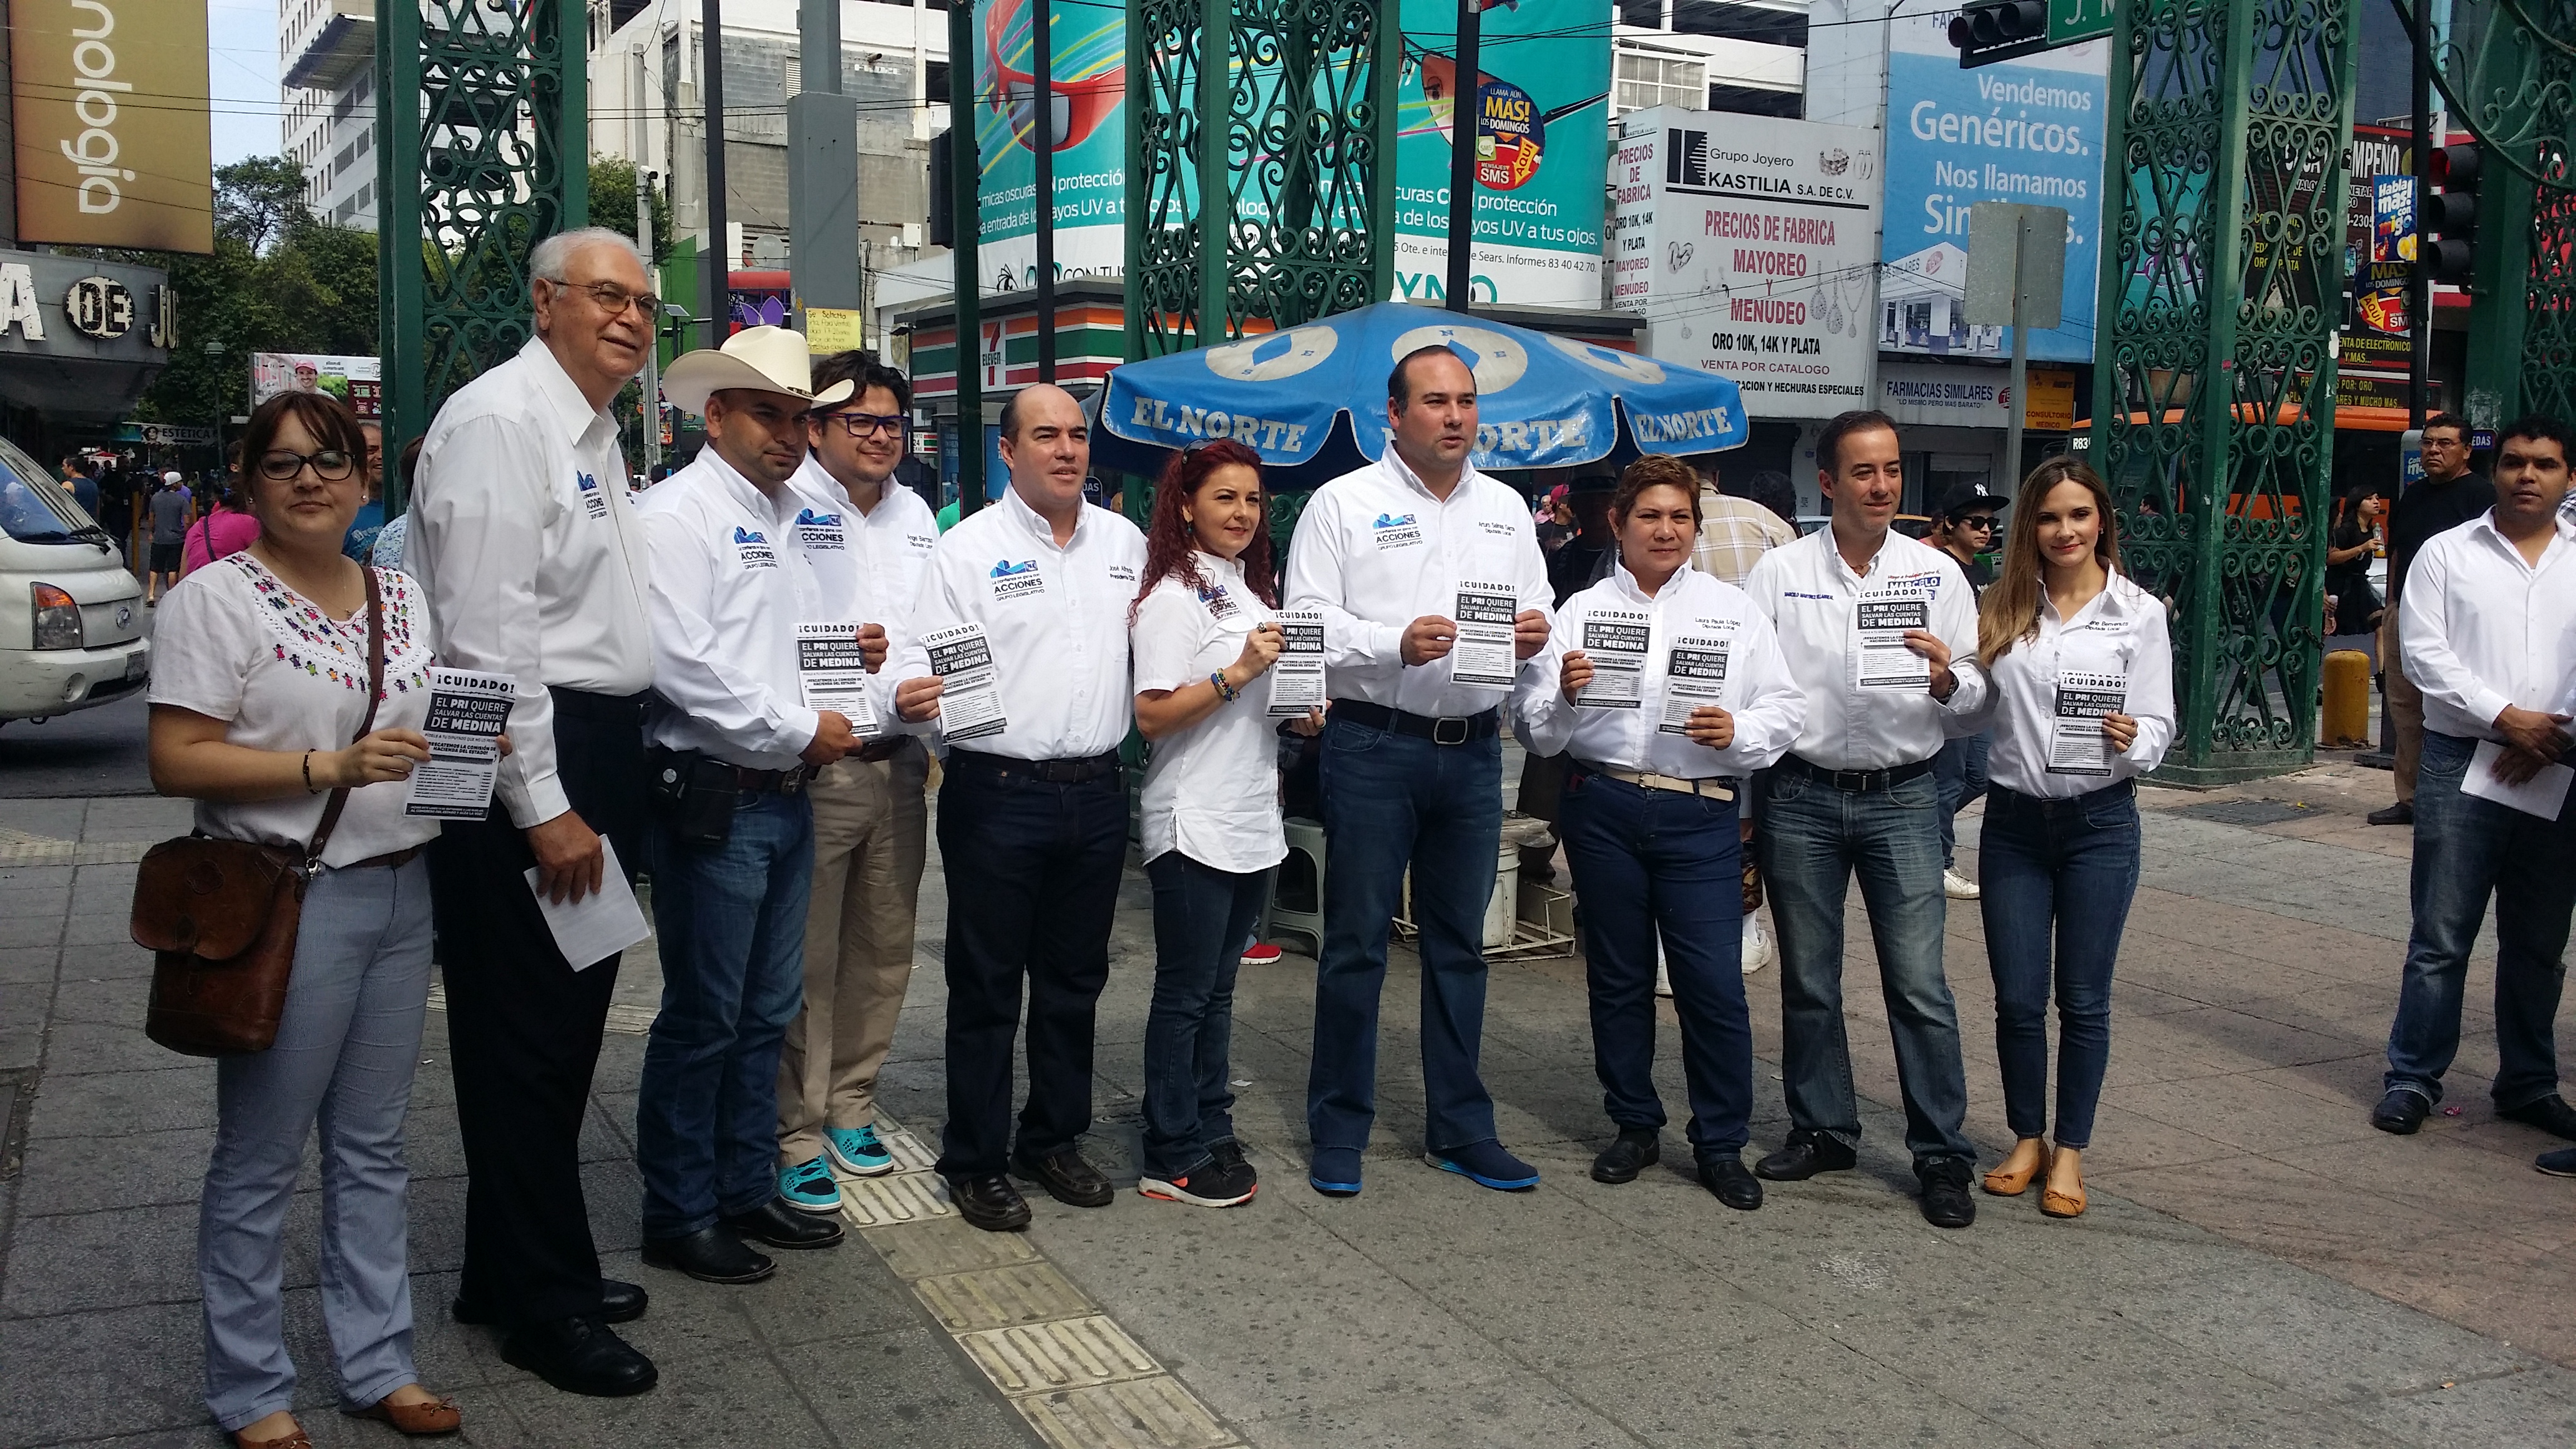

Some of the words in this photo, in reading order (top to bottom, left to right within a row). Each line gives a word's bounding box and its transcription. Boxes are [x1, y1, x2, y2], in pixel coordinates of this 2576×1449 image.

[1490, 88, 1508, 96] LLAMA
[1978, 72, 2091, 111] Vendemos
[1485, 96, 1530, 122] MÁS!
[1480, 117, 1490, 125] LOS
[1490, 118, 1530, 134] DOMINGOS
[1910, 99, 2089, 156] Genéricos.
[1619, 143, 1653, 165] PRECIOS
[1710, 147, 1749, 165] Grupo
[1752, 152, 1794, 168] Joyero
[2352, 135, 2399, 179] MPEÑO
[1481, 162, 1506, 170] MENSAJES
[1480, 168, 1509, 184] SMS
[1630, 166, 1640, 183] DE
[1935, 159, 1978, 189] Nos
[1984, 163, 2087, 199] llamamos
[982, 192, 1003, 207] micas
[1005, 183, 1037, 202] oscuras
[1058, 168, 1125, 193] protecció
[1709, 171, 1791, 194] KASTILIA
[1797, 183, 1817, 197] S.A.
[1819, 185, 1835, 198] DE
[1837, 186, 1854, 200] C.V.
[1617, 184, 1651, 205] FABRICA
[1478, 194, 1557, 217] protección
[2398, 207, 2411, 216] con
[987, 216, 1017, 232] entrada
[1019, 213, 1028, 225] de
[1081, 198, 1103, 216] UV
[1106, 202, 1116, 214] a
[1615, 217, 1627, 230] ORO
[1629, 214, 1641, 228] 10K,
[1642, 212, 1653, 225] 14K
[1403, 211, 1423, 227] de
[1427, 211, 1449, 229] los
[1501, 220, 1526, 237] UV
[1528, 225, 1537, 237] a
[1540, 227, 1564, 242] tus
[1567, 229, 1598, 246] ojos.
[1705, 210, 1760, 241] PRECIOS
[1764, 215, 1780, 242] DE
[1783, 217, 1836, 246] FABRICA
[1623, 239, 1627, 251] Y
[1628, 237, 1645, 251] PLATA
[1402, 243, 1420, 255] Ote.
[1422, 245, 1428, 255] e
[1479, 252, 1504, 264] Sears.
[1506, 255, 1546, 268] Informes
[1548, 259, 1559, 268] 83
[1561, 260, 1571, 270] 40
[1574, 261, 1584, 271] 42
[1586, 262, 1596, 273] 70.
[1616, 257, 1649, 273] MAYOREO
[1734, 249, 1807, 277] MAYOREO
[1630, 273, 1633, 281] Y
[1614, 281, 1649, 296] MENUDEO
[1766, 278, 1772, 296] Y
[79, 282, 126, 332] DE
[1615, 300, 1634, 308] VENTA
[1730, 298, 1806, 325] MENUDEO
[1712, 332, 1734, 351] ORO
[1736, 334, 1757, 356] 10K,
[1760, 336, 1780, 353] 14K
[1782, 337, 1789, 353] Y
[1791, 338, 1820, 356] PLATA
[2356, 338, 2365, 349] DE
[2366, 339, 2411, 352] ELECTRONICO
[2344, 353, 2349, 361] Y
[2350, 353, 2372, 363] MAS...
[1700, 359, 1738, 370] VENTA
[1742, 362, 1765, 372] POR
[1769, 363, 1830, 374] CATALOGO
[1767, 383, 1773, 392] Y
[1775, 382, 1817, 394] HECHURAS
[1818, 384, 1864, 396] ESPECIALES
[1886, 381, 1943, 398] FARMACIAS
[1944, 383, 1993, 401] SIMILARES
[2341, 379, 2356, 389] POR:
[2359, 381, 2372, 391] ORO
[2354, 395, 2359, 404] Y
[2360, 396, 2382, 407] MUCHO
[2026, 411, 2072, 419] CONSULTORIO
[1131, 396, 1174, 431] EL
[1176, 405, 1307, 452] NORTE
[1634, 413, 1660, 442] EL
[1656, 407, 1734, 440] NORTE
[1475, 418, 1586, 453] ORTE
[2073, 437, 2091, 450] R83
[802, 533, 844, 542] CCIONES
[1376, 530, 1421, 544] ACCIONES
[741, 551, 774, 560] ACCIONES
[994, 578, 1043, 594] ACCIONES
[1013, 589, 1045, 598] LEGISLATIVO
[1460, 580, 1515, 592] ¡CUIDADO!
[1860, 588, 1922, 598] ¡CUIDADO!
[1461, 596, 1470, 604] EL
[1471, 597, 1485, 605] PRI
[1486, 598, 1513, 608] QUIERE
[1460, 611, 1473, 619] DE
[1474, 612, 1513, 623] MEDINA
[1588, 610, 1649, 620] ¡CUIDADO!
[1877, 617, 1922, 627] MEDINA
[926, 624, 980, 642] ¡CUIDADO!
[802, 643, 811, 651] EL
[813, 642, 828, 650] PRI
[829, 642, 859, 650] QUIERE
[1603, 640, 1645, 651] MEDINA
[1677, 637, 1729, 648] ¡CUIDADO!
[803, 658, 818, 668] DE
[819, 658, 861, 667] MEDINA
[950, 655, 990, 671] MEDINA
[1688, 666, 1724, 677] MEDINA
[437, 674, 515, 693] ¡CUIDADO!
[2063, 676, 2127, 688] ¡CUIDADO!
[436, 697, 447, 708] EL
[450, 699, 469, 710] PRI
[471, 700, 507, 713] QUIERE
[434, 709, 460, 718] SALVAR
[461, 711, 474, 719] LAS
[474, 712, 503, 721] CUENTAS
[430, 718, 447, 728] DE
[451, 720, 501, 733] MEDINA
